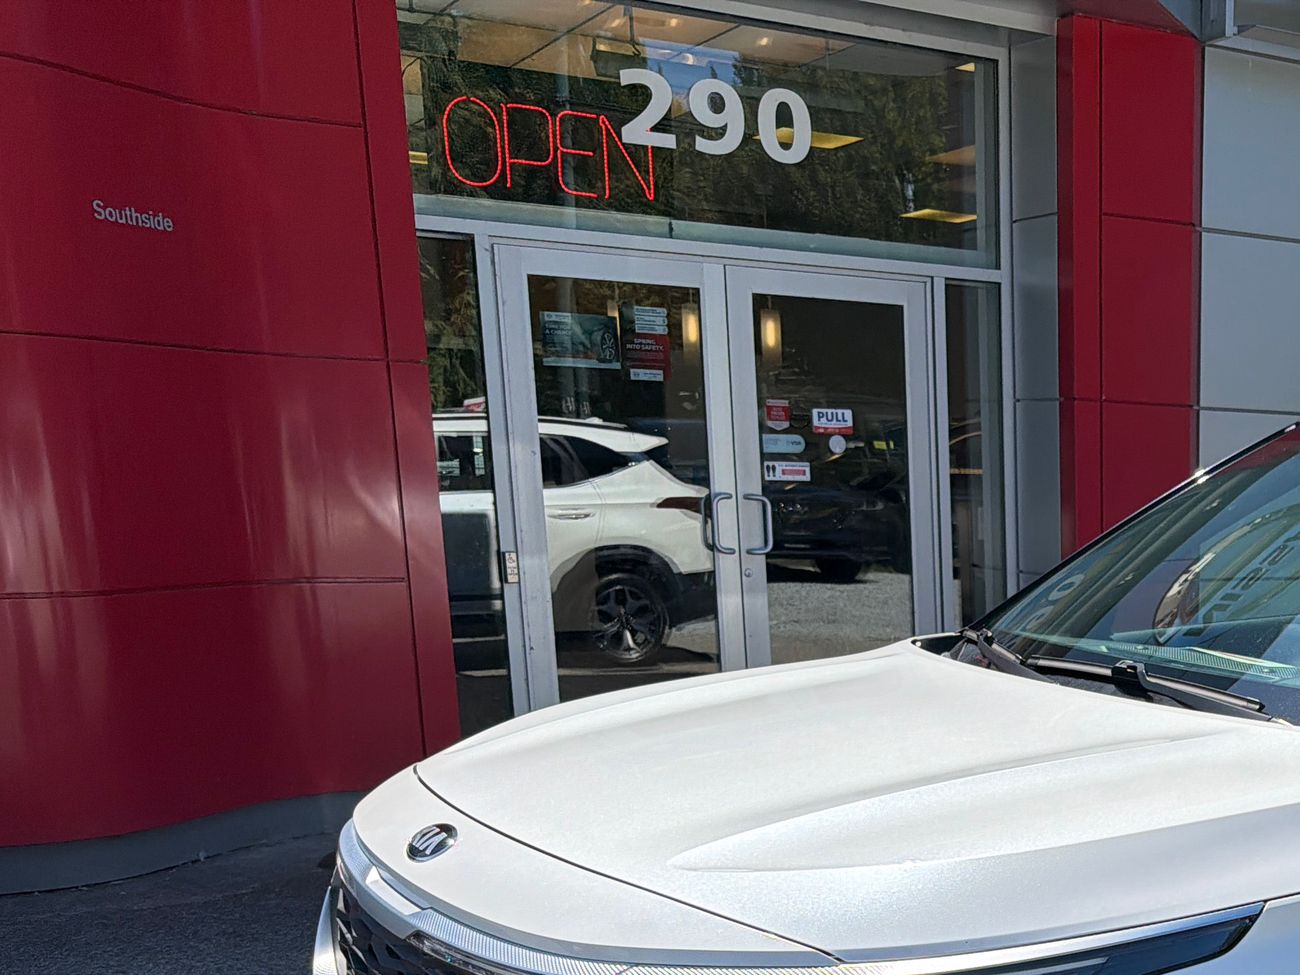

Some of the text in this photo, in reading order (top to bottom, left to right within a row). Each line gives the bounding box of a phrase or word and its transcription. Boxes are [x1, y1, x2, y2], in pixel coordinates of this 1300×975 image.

[442, 95, 655, 201] OPEN
[619, 67, 812, 164] 290
[92, 199, 174, 232] Southside
[817, 411, 848, 423] PULL
